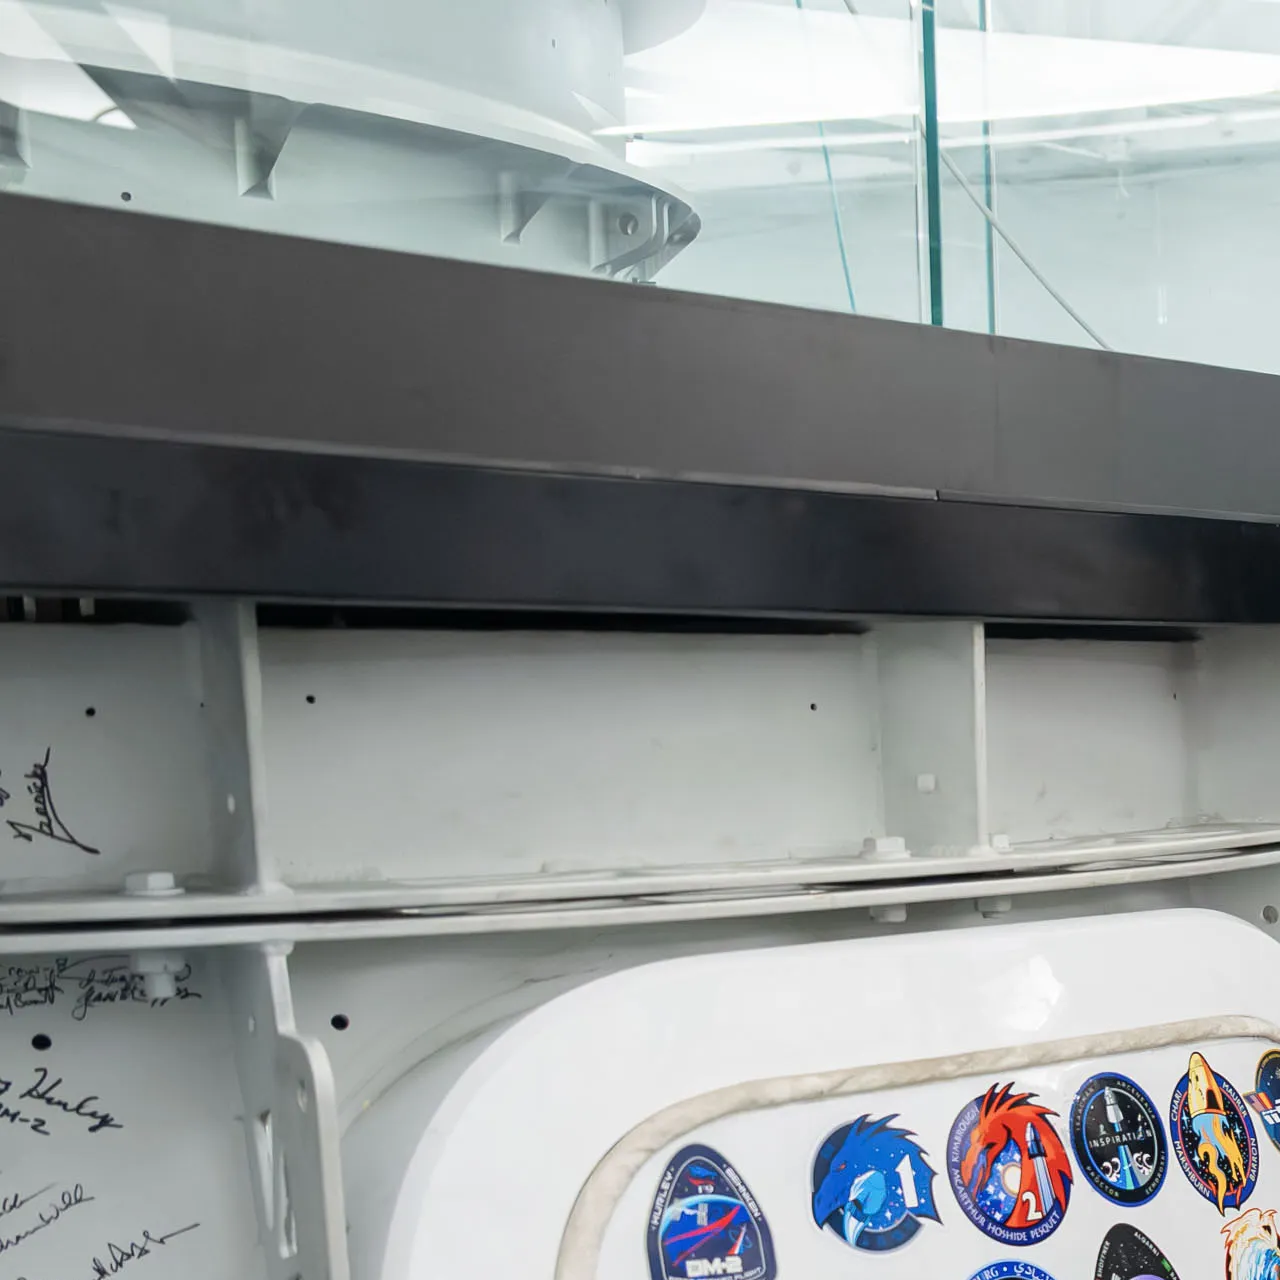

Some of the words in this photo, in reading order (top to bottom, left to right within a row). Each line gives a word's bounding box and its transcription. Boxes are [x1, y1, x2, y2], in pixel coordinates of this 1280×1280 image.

[1171, 1089, 1183, 1122] CHARI
[1222, 1081, 1248, 1118] MAURER
[952, 1103, 980, 1163] KIMBROUGH
[987, 1222, 1028, 1241] HOSHIDE
[1030, 1210, 1061, 1240] PESQUET
[1174, 1140, 1211, 1198] MARSHBURN
[1249, 1137, 1258, 1182] BARRON
[651, 1171, 673, 1226] HURLEY
[1022, 1191, 1043, 1221] 2
[685, 1256, 743, 1279] DM-2
[1097, 1240, 1111, 1277] SHOFFNER
